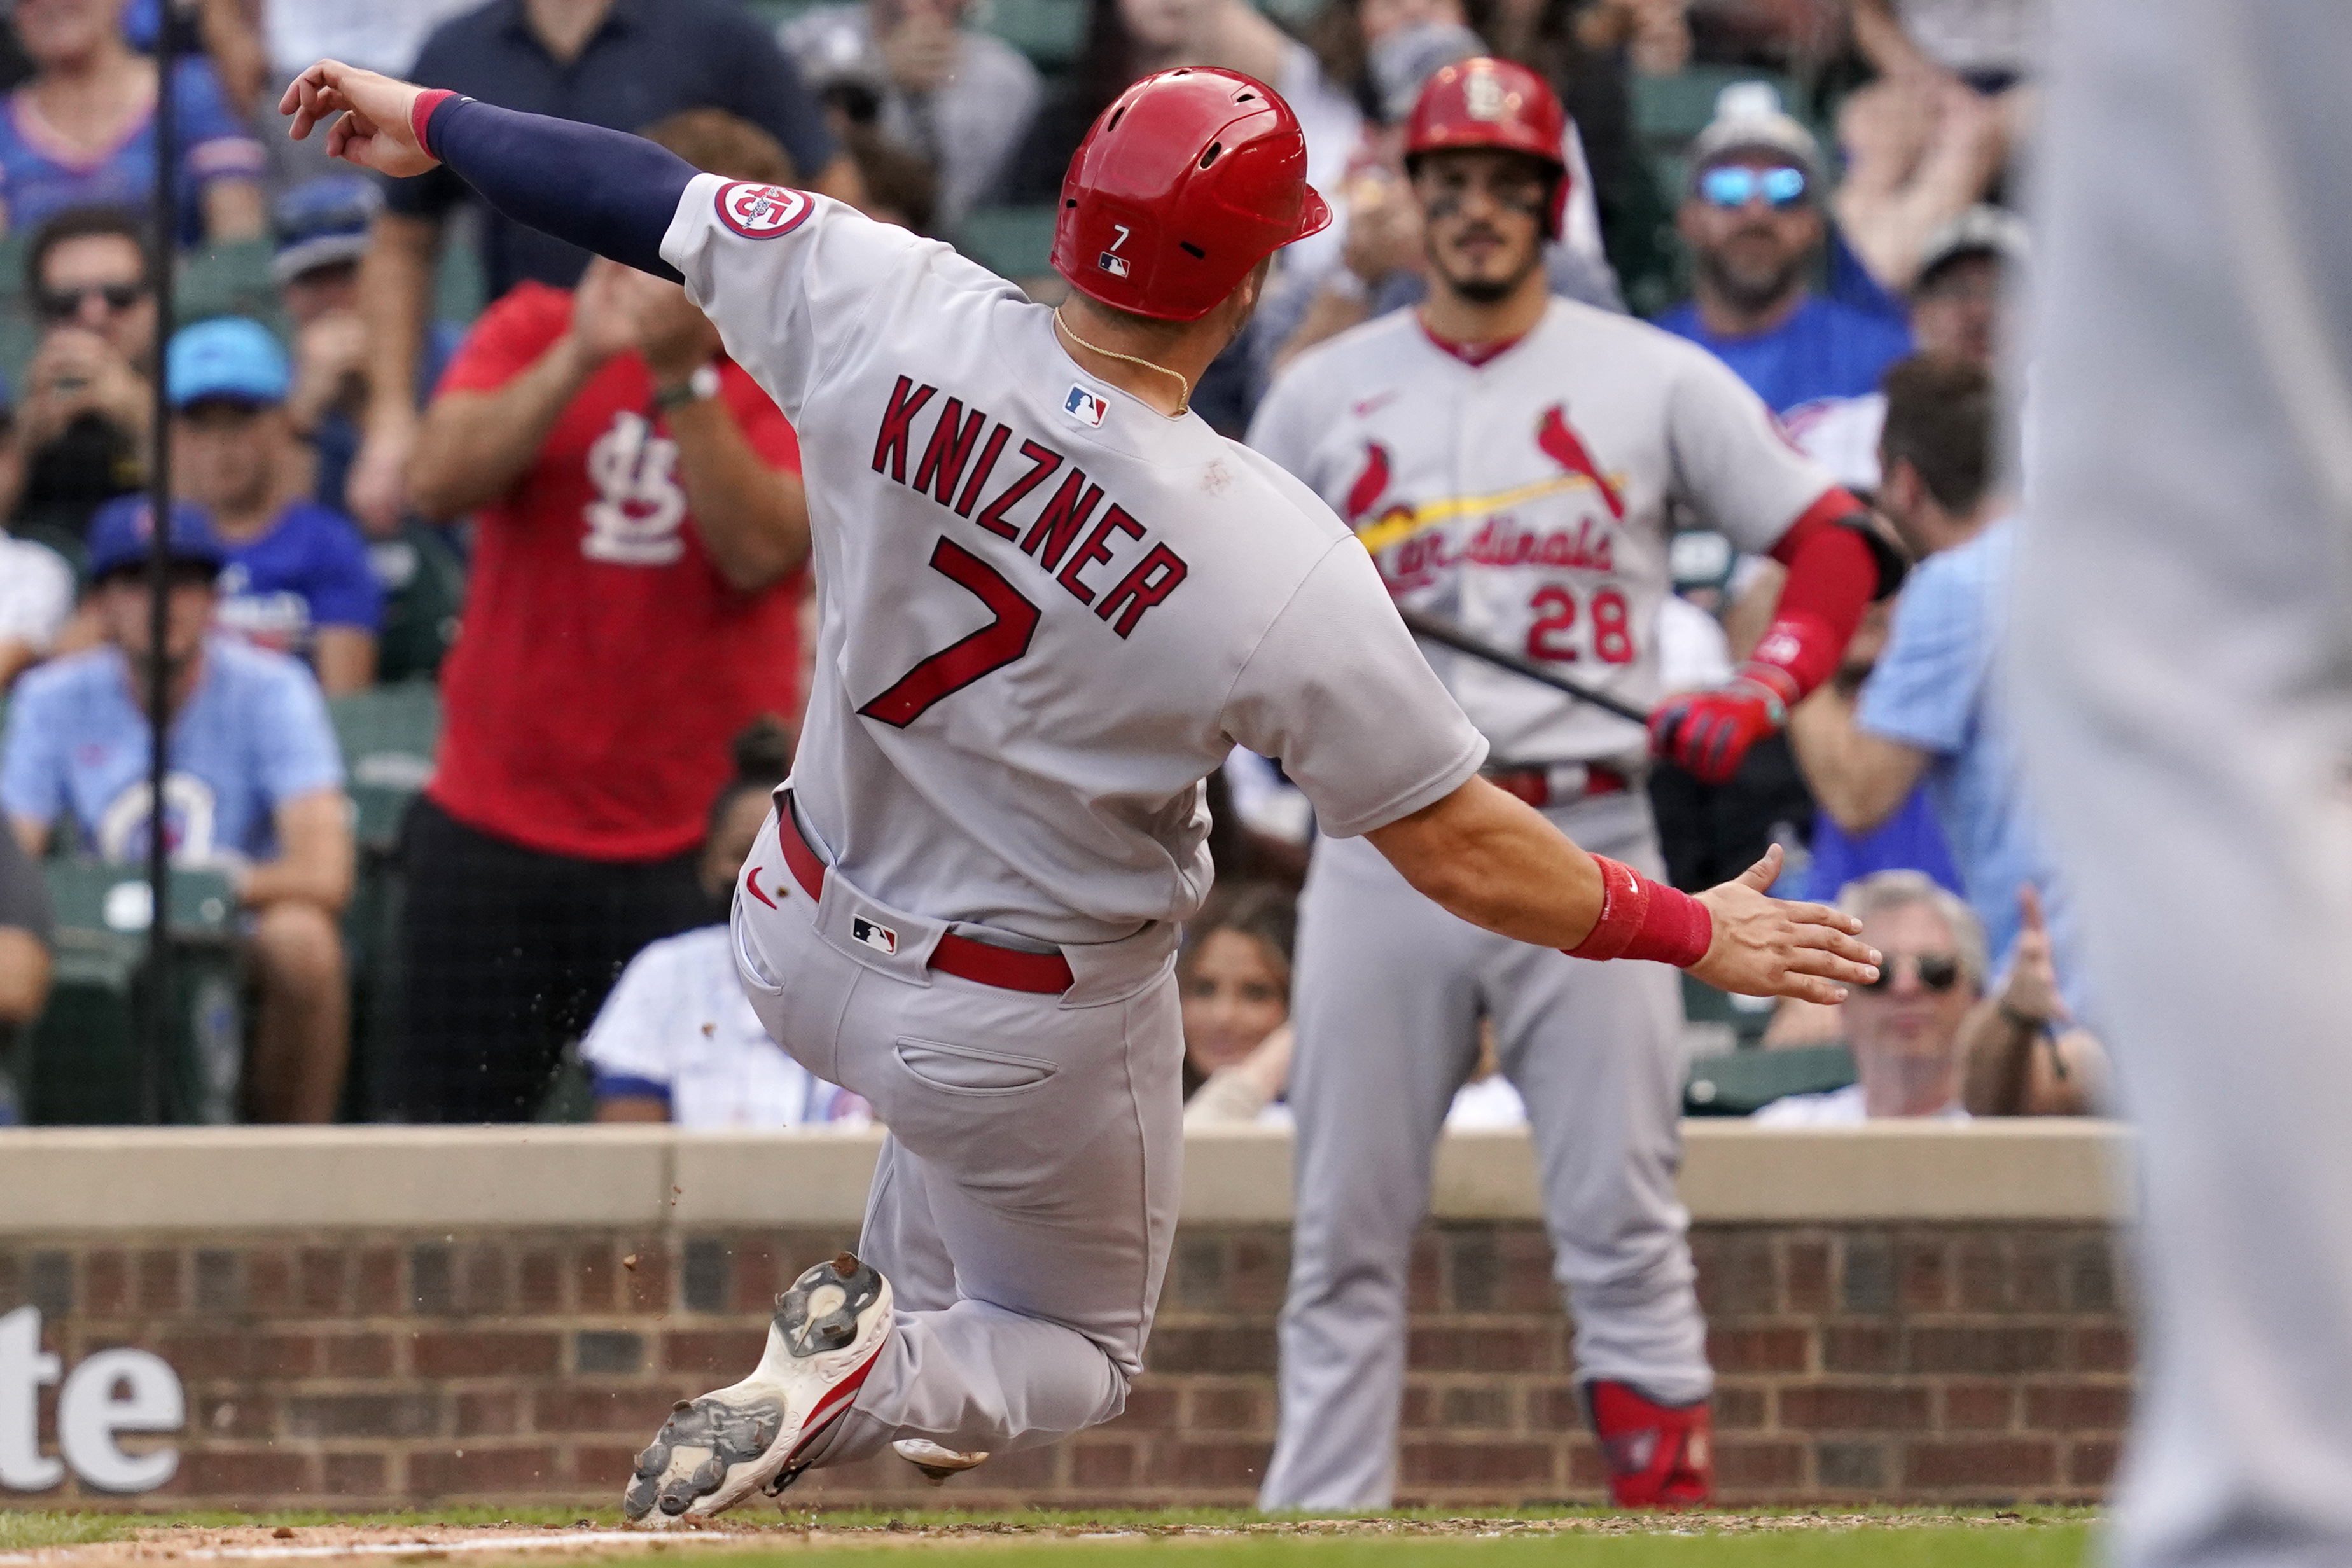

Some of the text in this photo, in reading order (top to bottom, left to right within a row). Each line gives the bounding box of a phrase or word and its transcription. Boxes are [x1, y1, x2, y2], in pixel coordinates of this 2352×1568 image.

[1110, 223, 1129, 251] 7
[872, 374, 1188, 640] KNIZNER
[856, 534, 1042, 729] 7
[1529, 584, 1635, 665] 28
